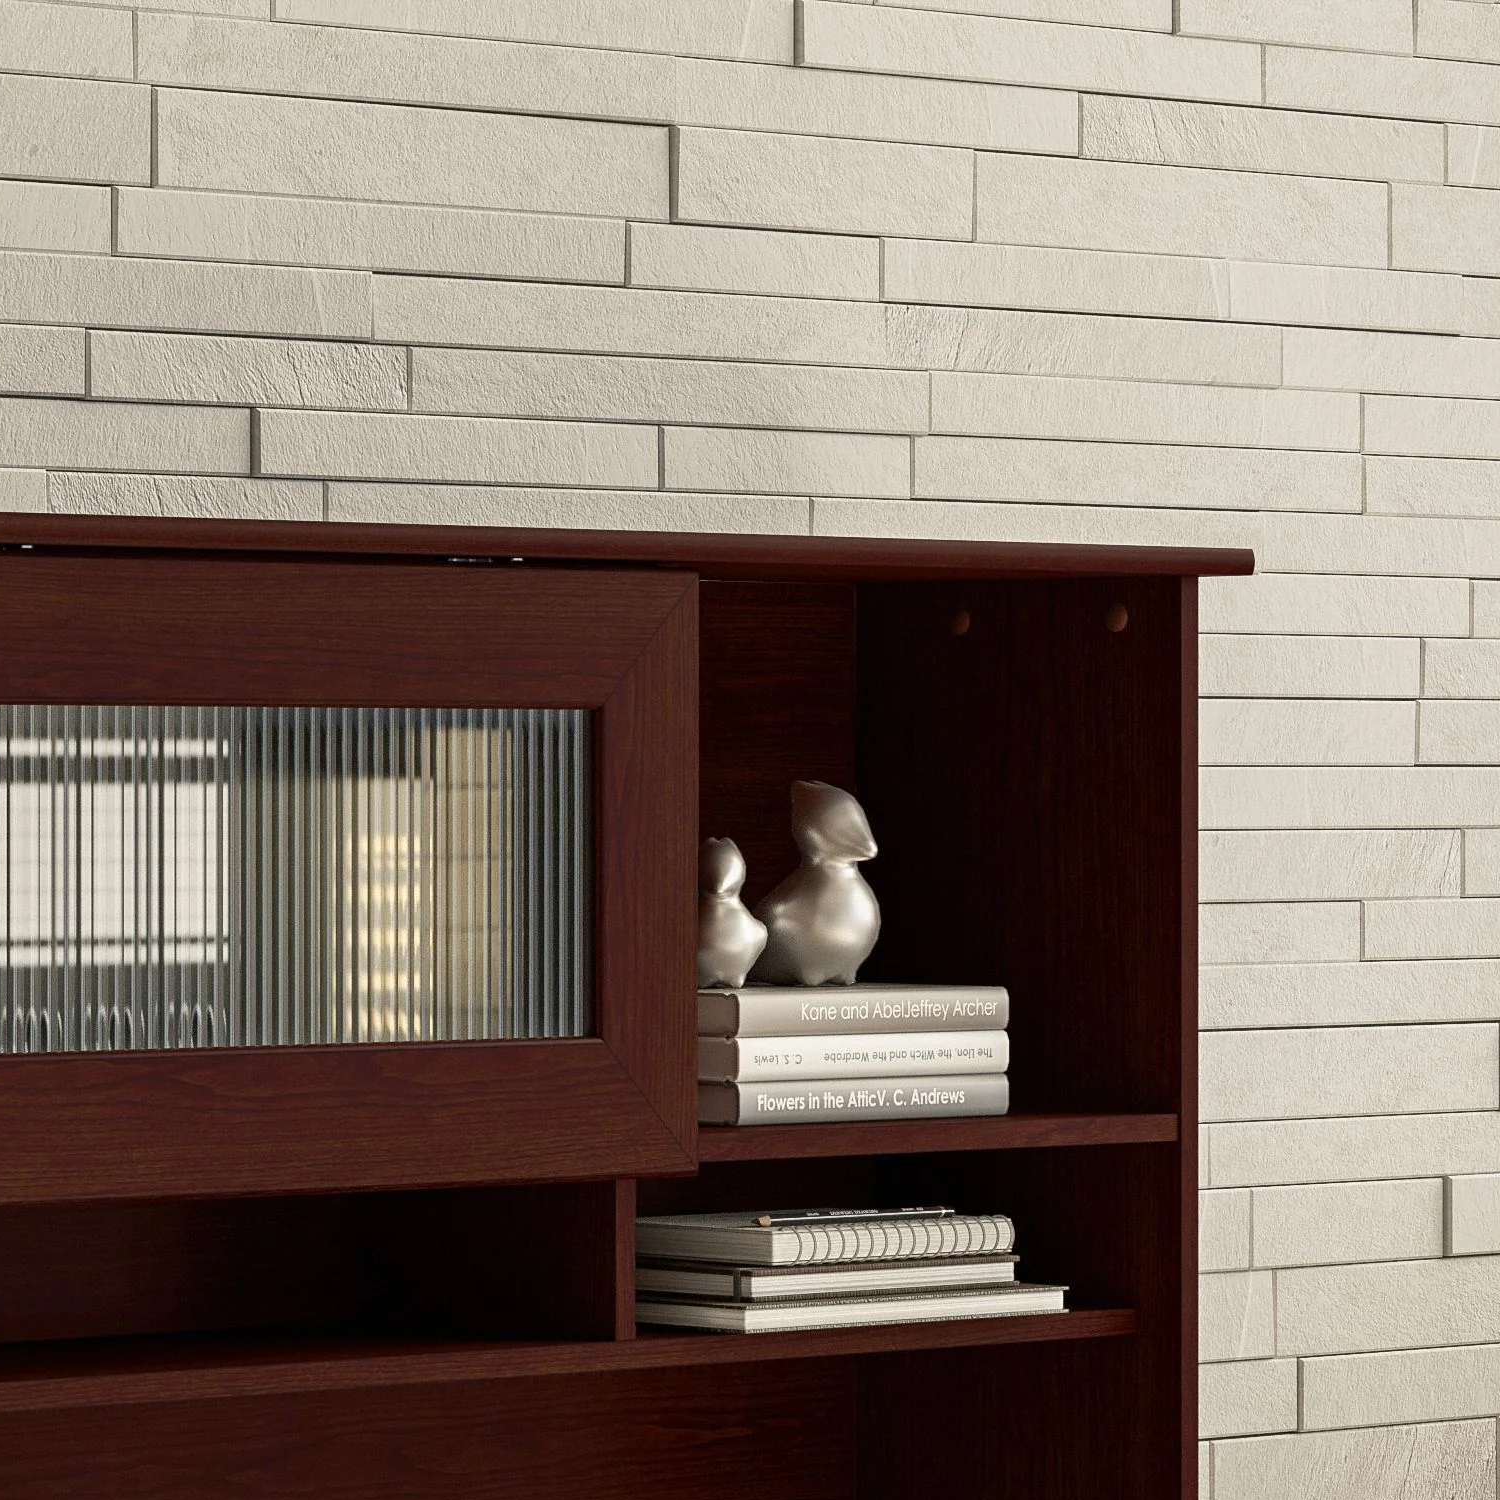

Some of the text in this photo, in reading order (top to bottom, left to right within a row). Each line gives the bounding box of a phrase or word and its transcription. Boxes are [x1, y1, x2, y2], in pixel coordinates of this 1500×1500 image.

[801, 1003, 837, 1021] Kane
[840, 1002, 869, 1020] and
[953, 998, 998, 1017] Archer
[823, 1052, 870, 1064] Wardrobe
[871, 1051, 887, 1062] the
[889, 1051, 908, 1062] and
[910, 1050, 935, 1061] Witch
[937, 1049, 953, 1060] the
[977, 1047, 993, 1059] The
[754, 1054, 779, 1066] Lewis
[757, 1094, 806, 1112] Flowers
[808, 1092, 820, 1110] in
[823, 1091, 845, 1109] the
[893, 1088, 907, 1106] C.
[910, 1087, 965, 1106] Andrews
